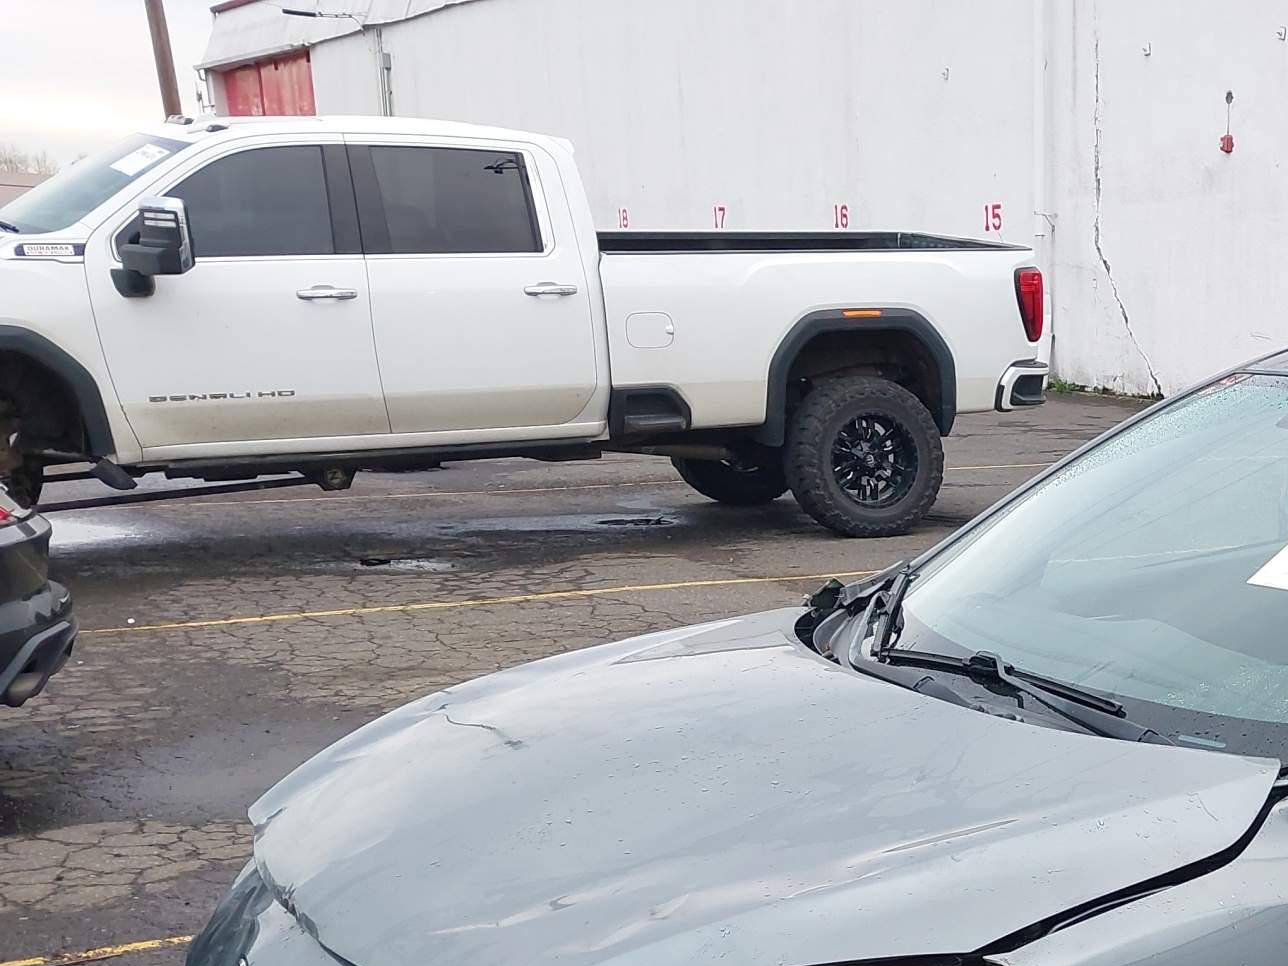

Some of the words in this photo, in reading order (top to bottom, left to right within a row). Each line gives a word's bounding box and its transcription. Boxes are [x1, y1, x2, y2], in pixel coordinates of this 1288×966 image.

[618, 208, 628, 229] 18
[713, 206, 725, 228] 17
[834, 204, 849, 229] 16
[984, 204, 1002, 231] 15
